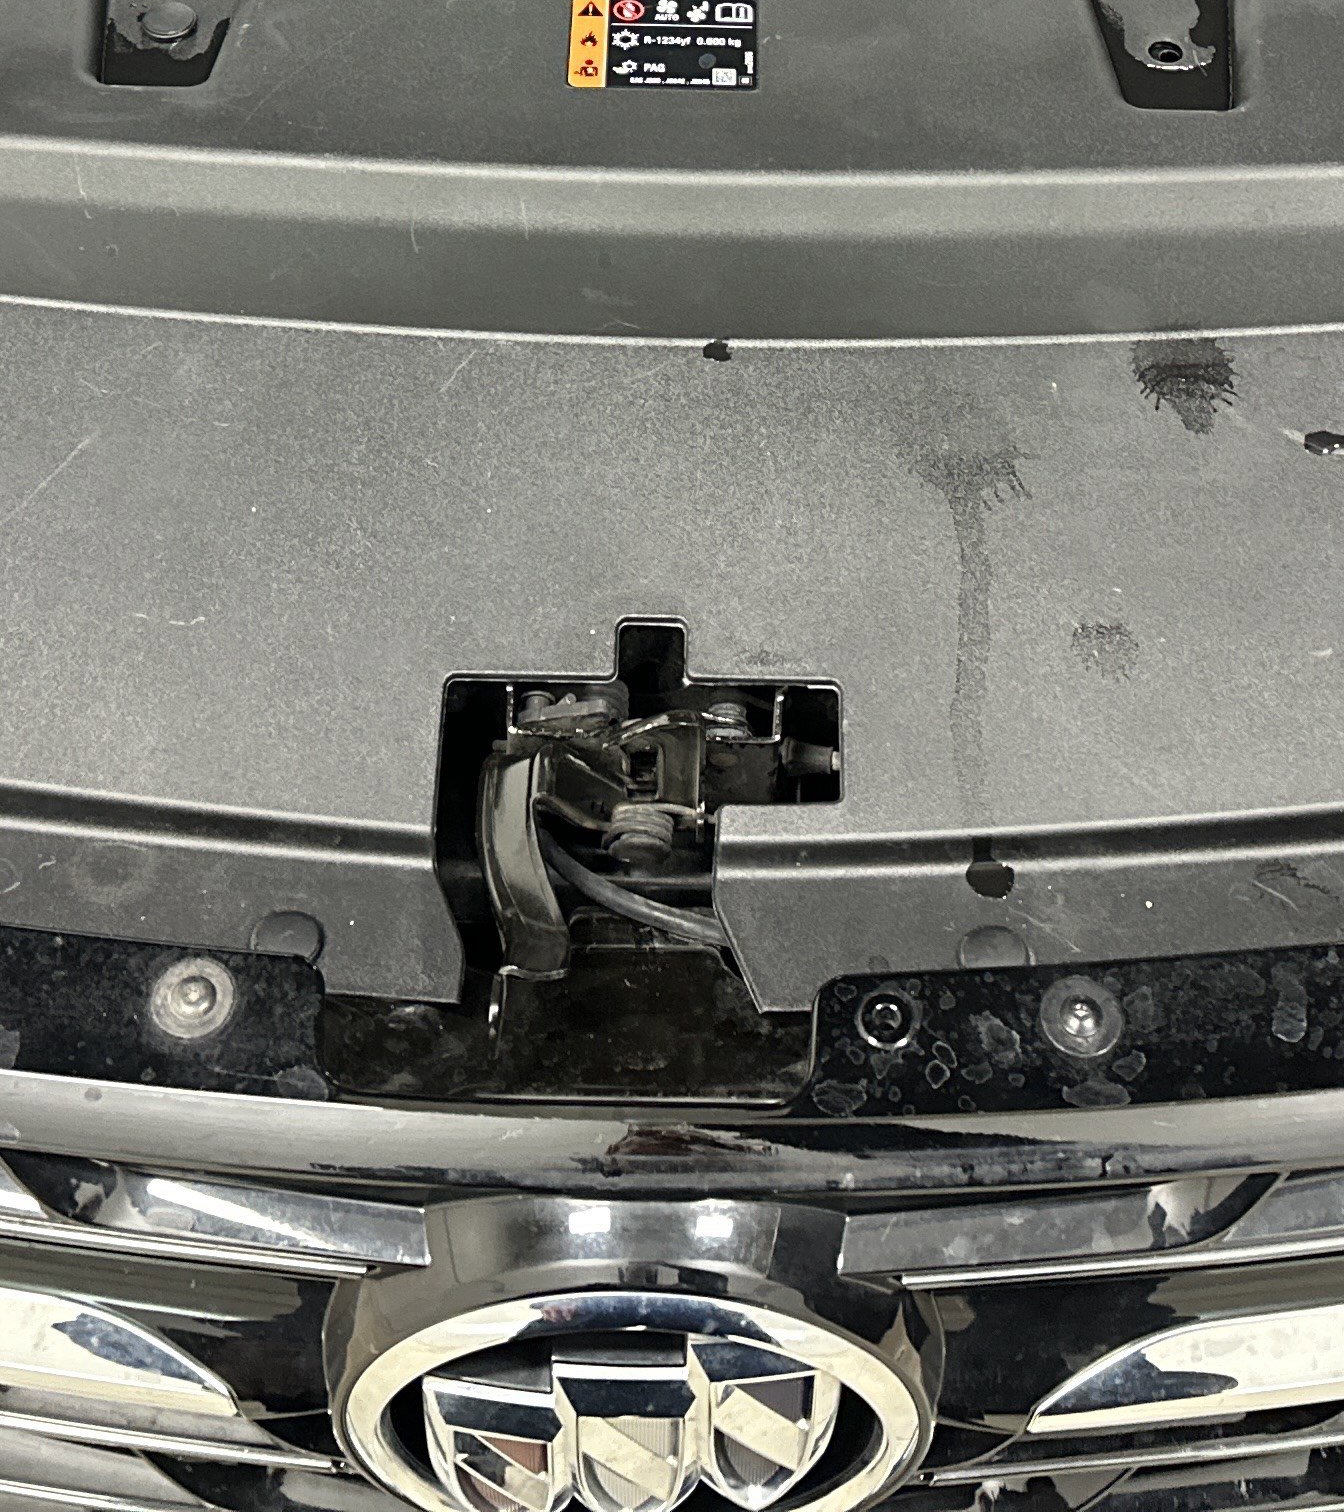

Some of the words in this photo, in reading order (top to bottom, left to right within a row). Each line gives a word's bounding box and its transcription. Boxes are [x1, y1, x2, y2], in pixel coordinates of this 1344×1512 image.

[655, 13, 680, 21] AUTO
[644, 36, 691, 46] R-1234yf
[728, 37, 742, 47] kg
[644, 62, 665, 73] PAG
